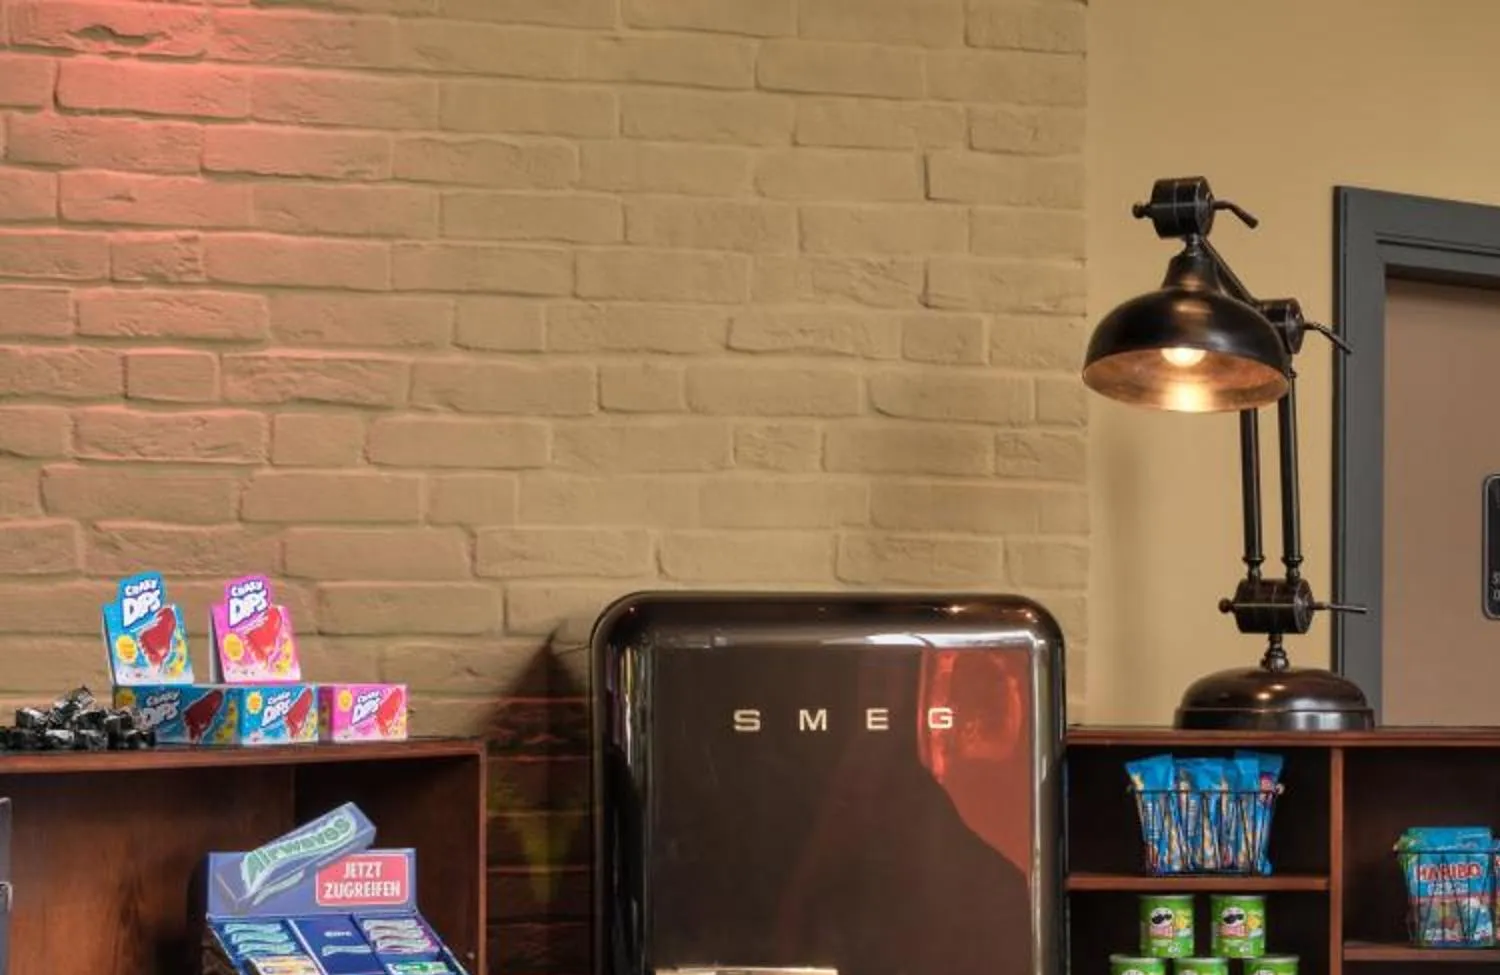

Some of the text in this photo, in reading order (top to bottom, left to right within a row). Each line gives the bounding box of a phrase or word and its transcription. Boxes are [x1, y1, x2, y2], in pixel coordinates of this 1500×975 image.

[122, 589, 162, 628] DIPS
[229, 590, 269, 628] DIPS
[733, 707, 954, 732] SMEG
[343, 861, 383, 879] JETZT
[323, 881, 401, 899] ZUGREIFEN
